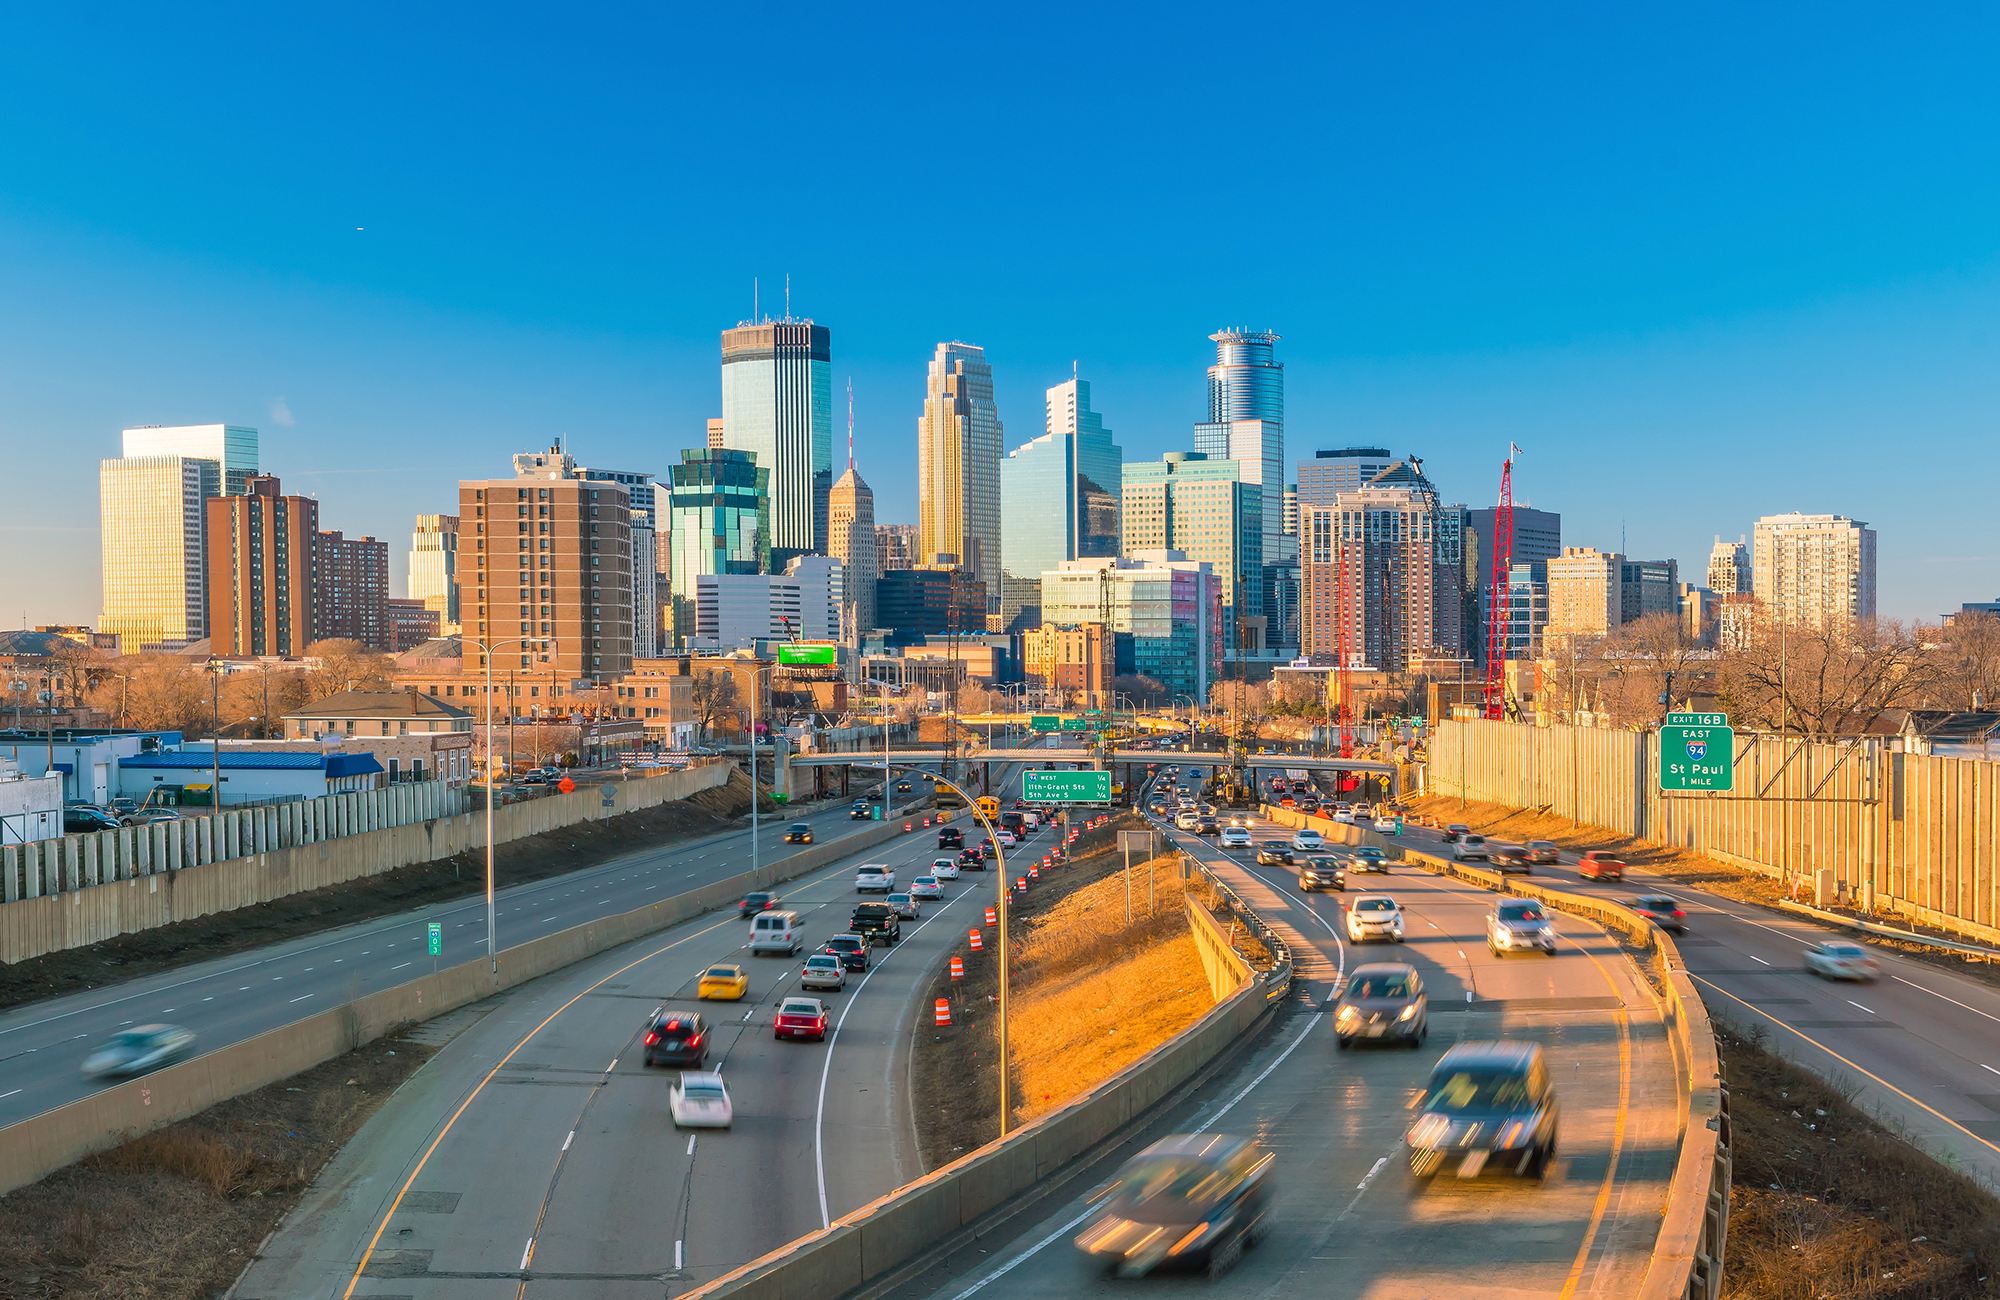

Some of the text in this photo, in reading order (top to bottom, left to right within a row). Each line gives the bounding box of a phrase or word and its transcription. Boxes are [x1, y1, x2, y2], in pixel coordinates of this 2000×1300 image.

[1698, 715, 1721, 725] 16B
[1682, 730, 1710, 738] EAST
[1689, 746, 1704, 756] 94
[1670, 764, 1723, 774] St Paul
[1681, 777, 1685, 786] 1
